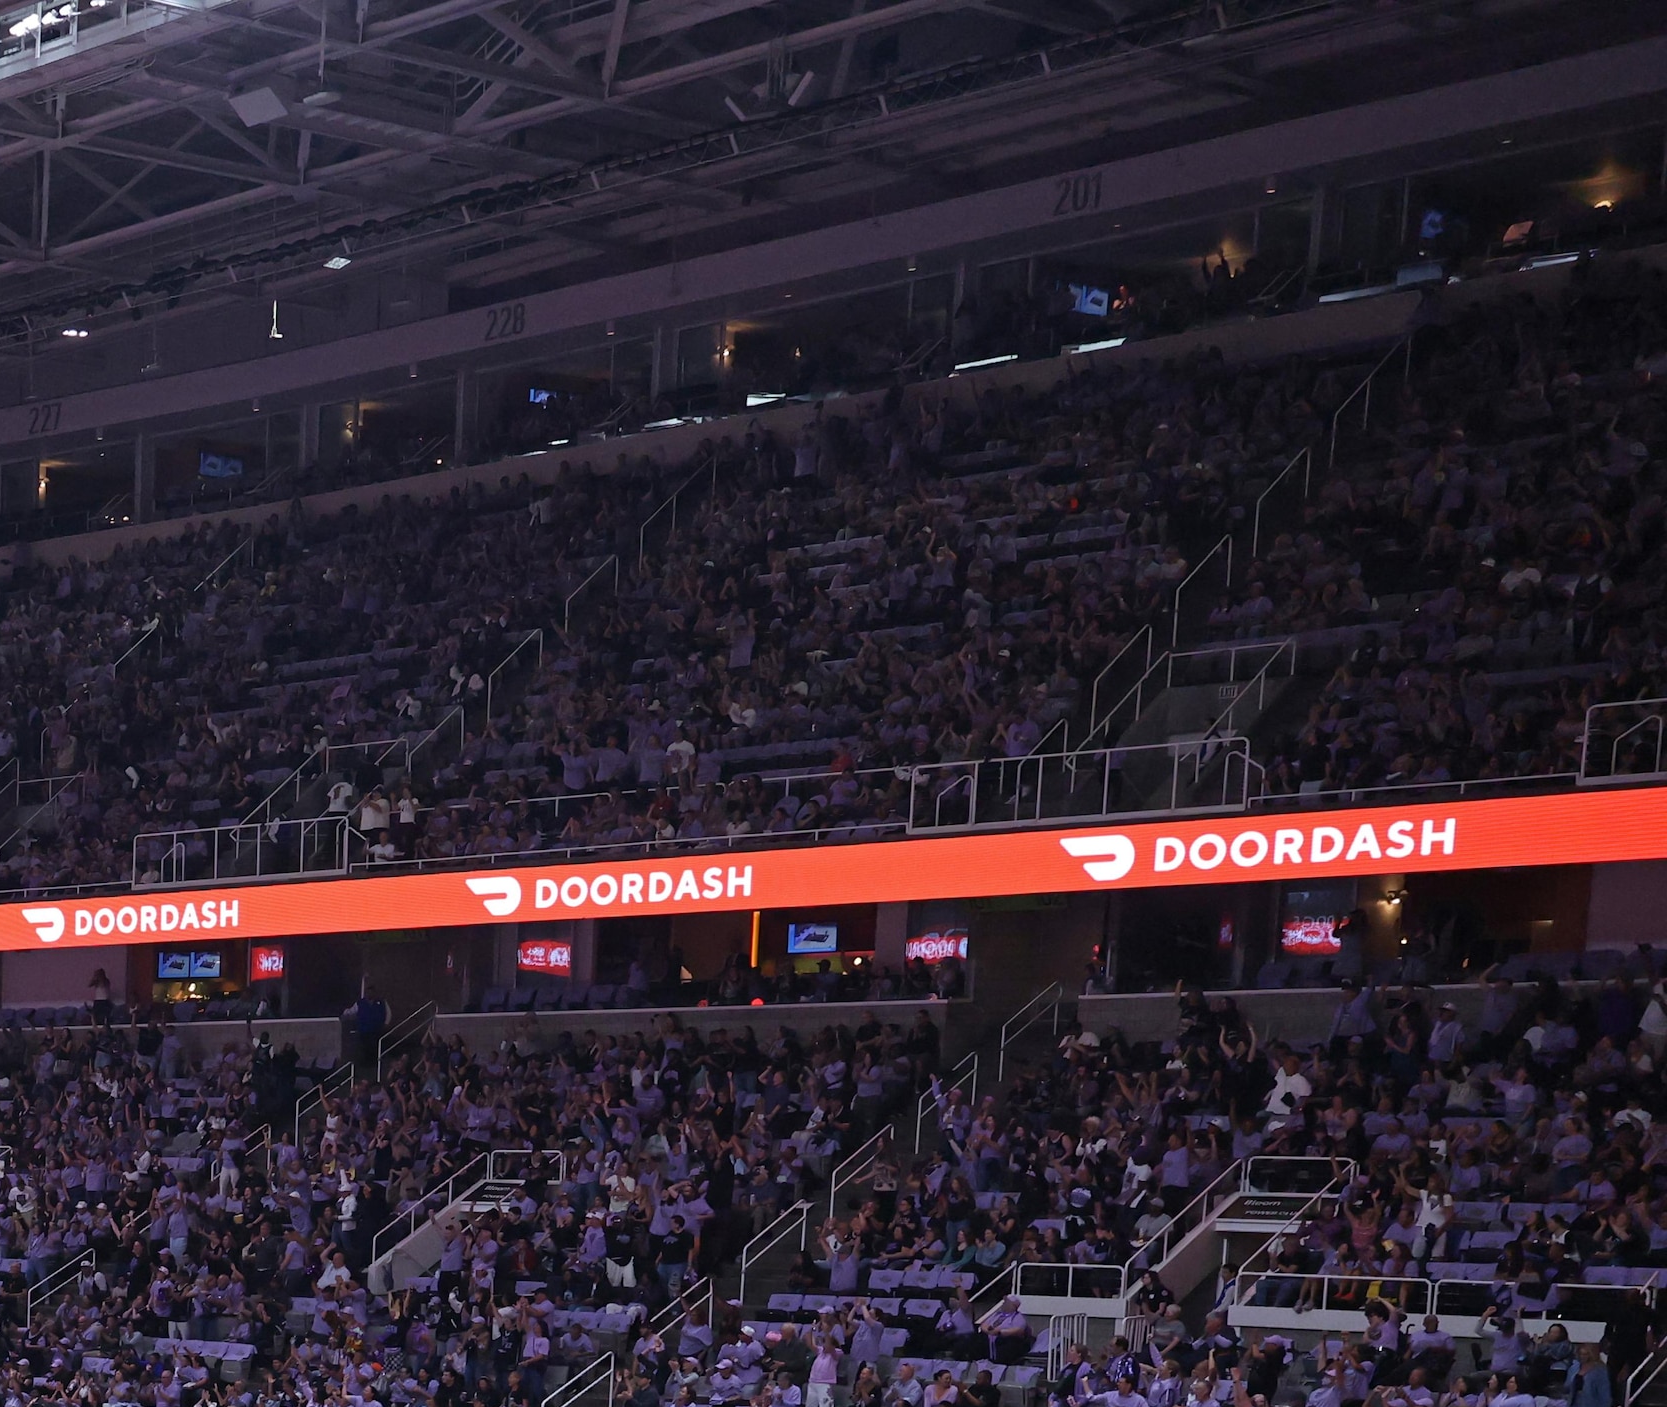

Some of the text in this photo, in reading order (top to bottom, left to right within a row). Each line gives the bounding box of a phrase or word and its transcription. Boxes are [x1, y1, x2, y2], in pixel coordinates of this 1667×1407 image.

[1053, 169, 1103, 215] 201
[484, 302, 524, 340] 228
[27, 400, 62, 434] 227
[1153, 817, 1458, 873] DOORDASH
[534, 864, 754, 910] DOORDASH
[74, 899, 240, 938] DOORDASH
